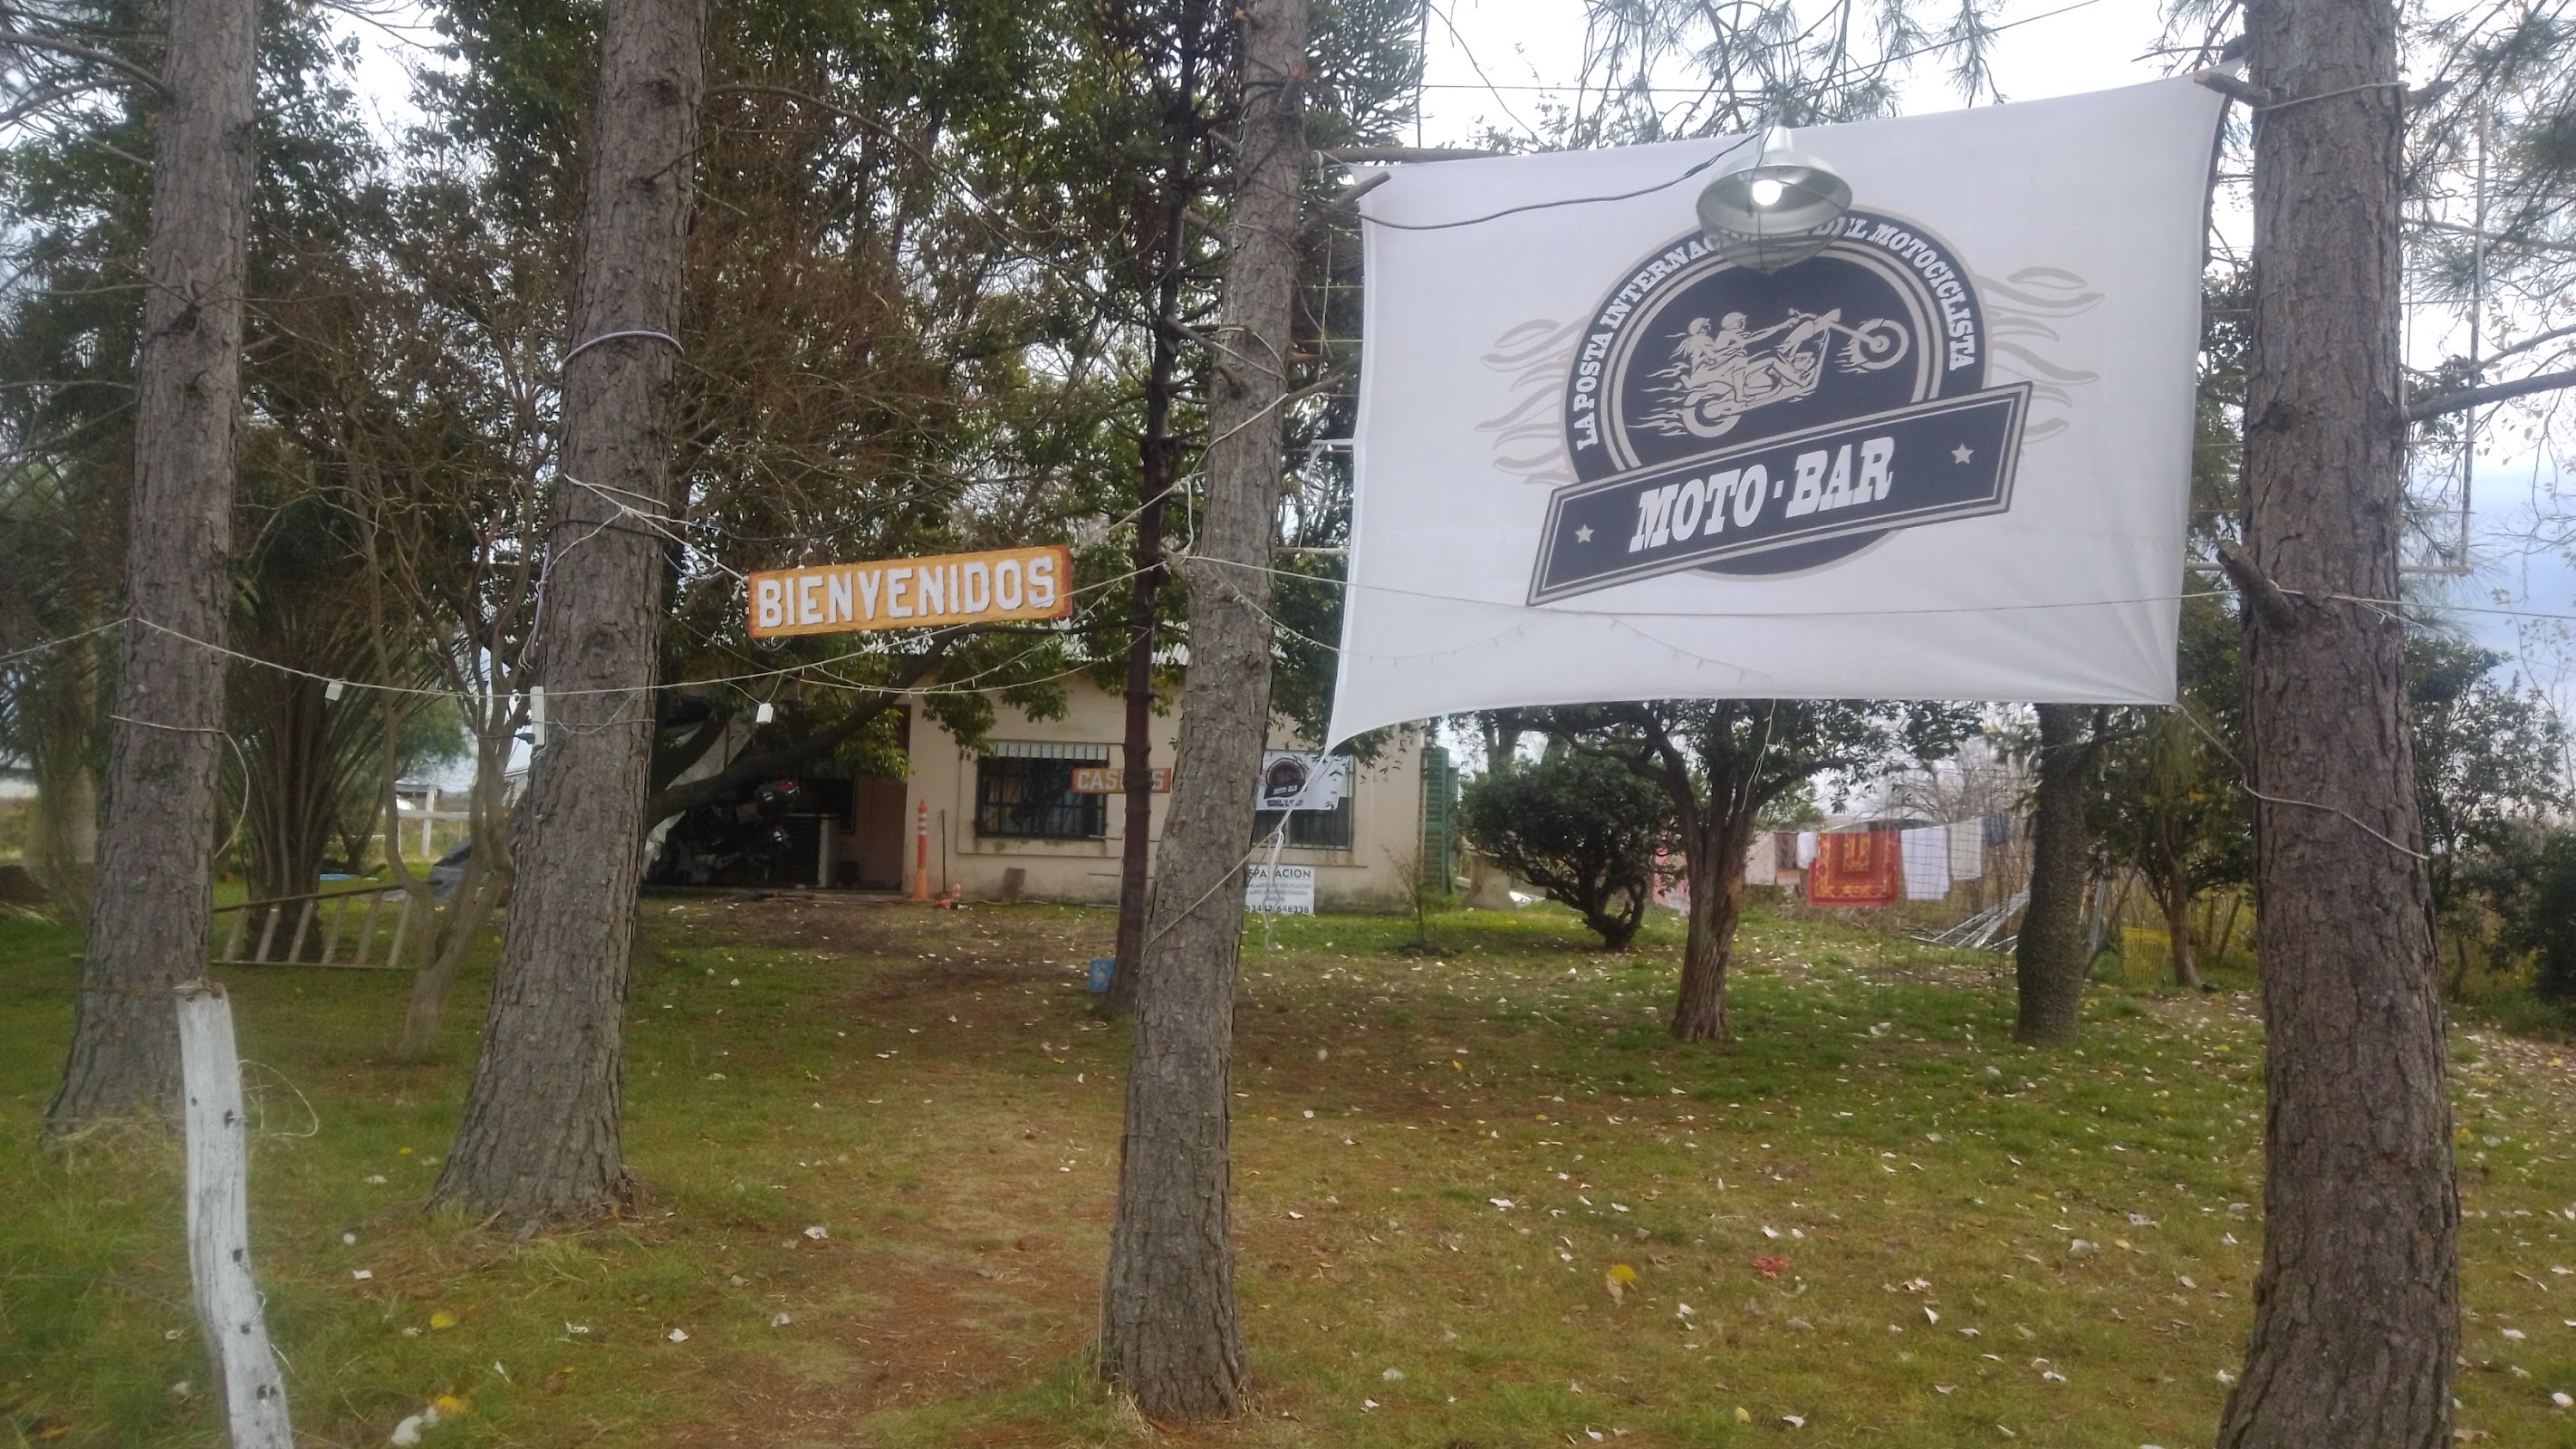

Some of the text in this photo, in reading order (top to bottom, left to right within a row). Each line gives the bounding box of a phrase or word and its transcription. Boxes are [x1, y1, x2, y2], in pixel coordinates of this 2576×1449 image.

[1599, 223, 1810, 330] INTERNAC
[1867, 223, 1975, 371] MOTOCICLISTA
[1573, 331, 1614, 412] POSTA
[1573, 411, 1600, 451] LA
[757, 555, 1055, 629] BIENVENIDOS
[1077, 770, 1165, 791] CASS
